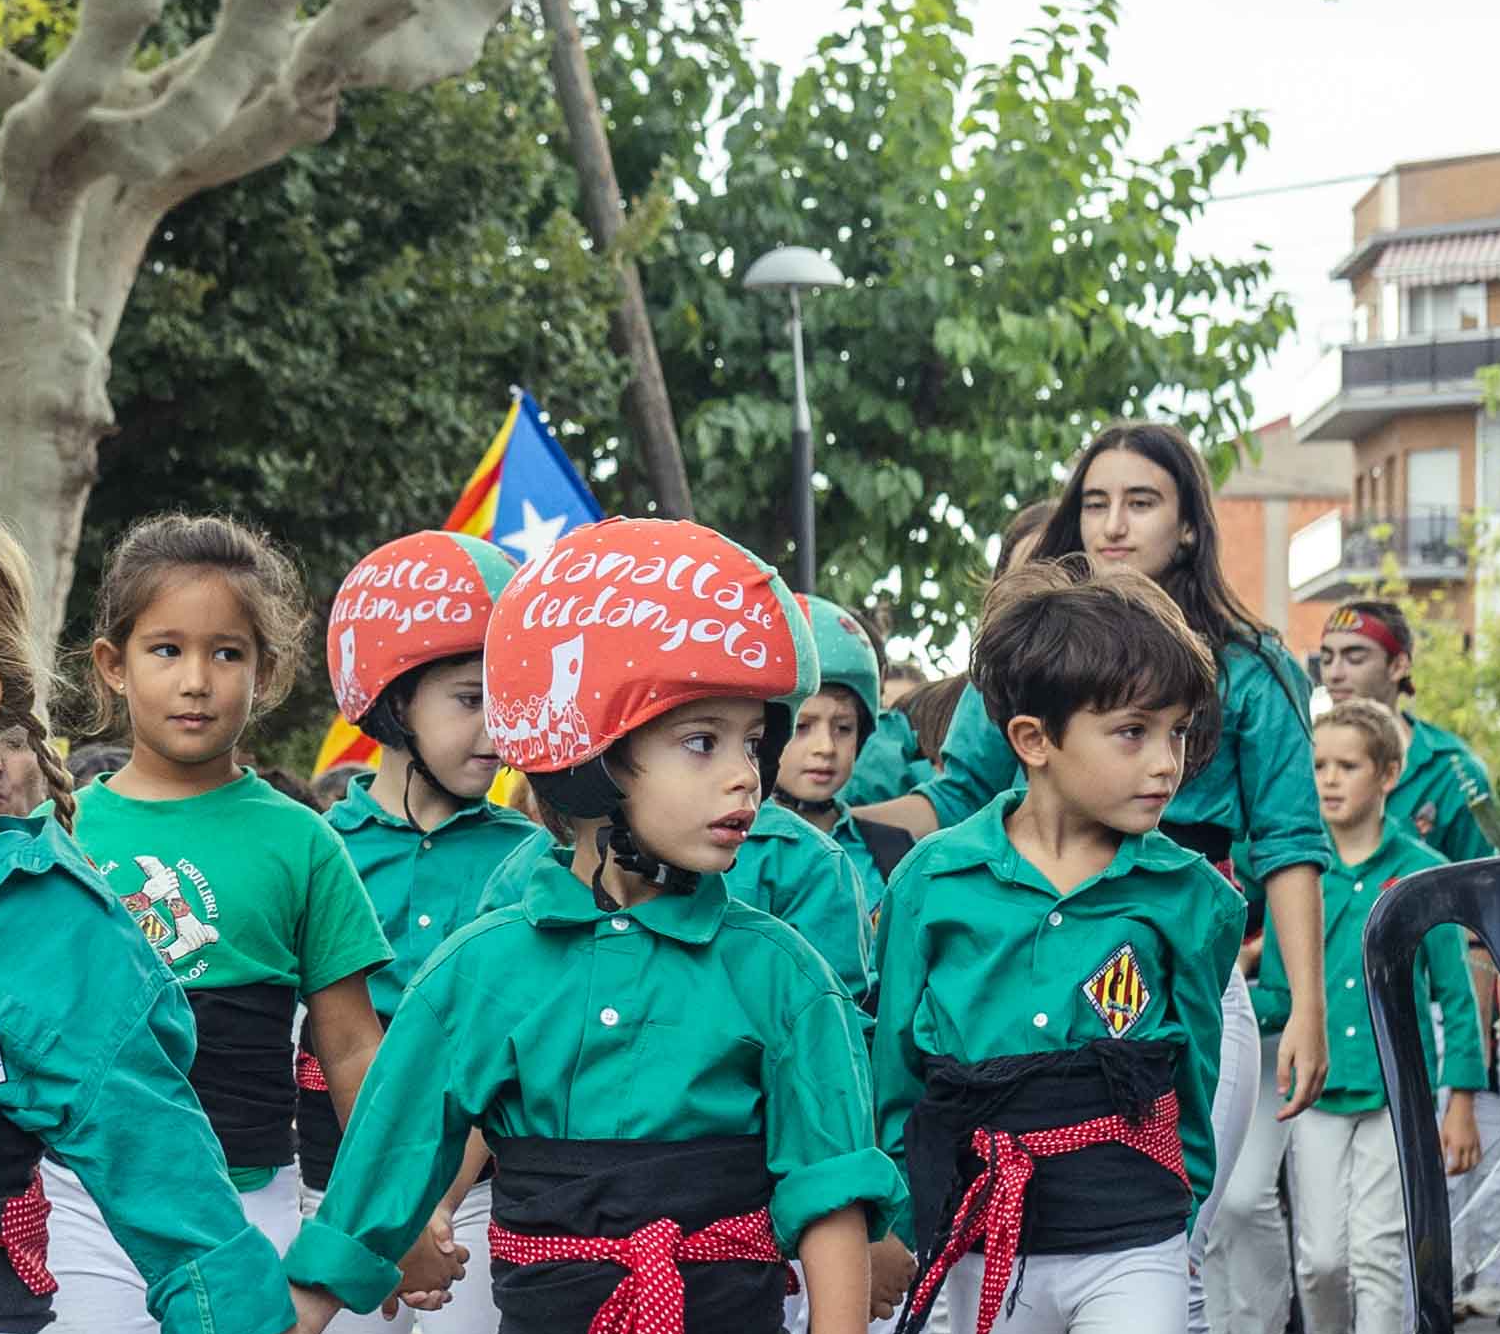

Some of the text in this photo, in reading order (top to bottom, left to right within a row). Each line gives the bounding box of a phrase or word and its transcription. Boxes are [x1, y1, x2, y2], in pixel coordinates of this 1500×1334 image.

[522, 585, 768, 669] Cerdanyola
[540, 547, 774, 630] Canalla de
[175, 857, 219, 921] EQUILIBRI
